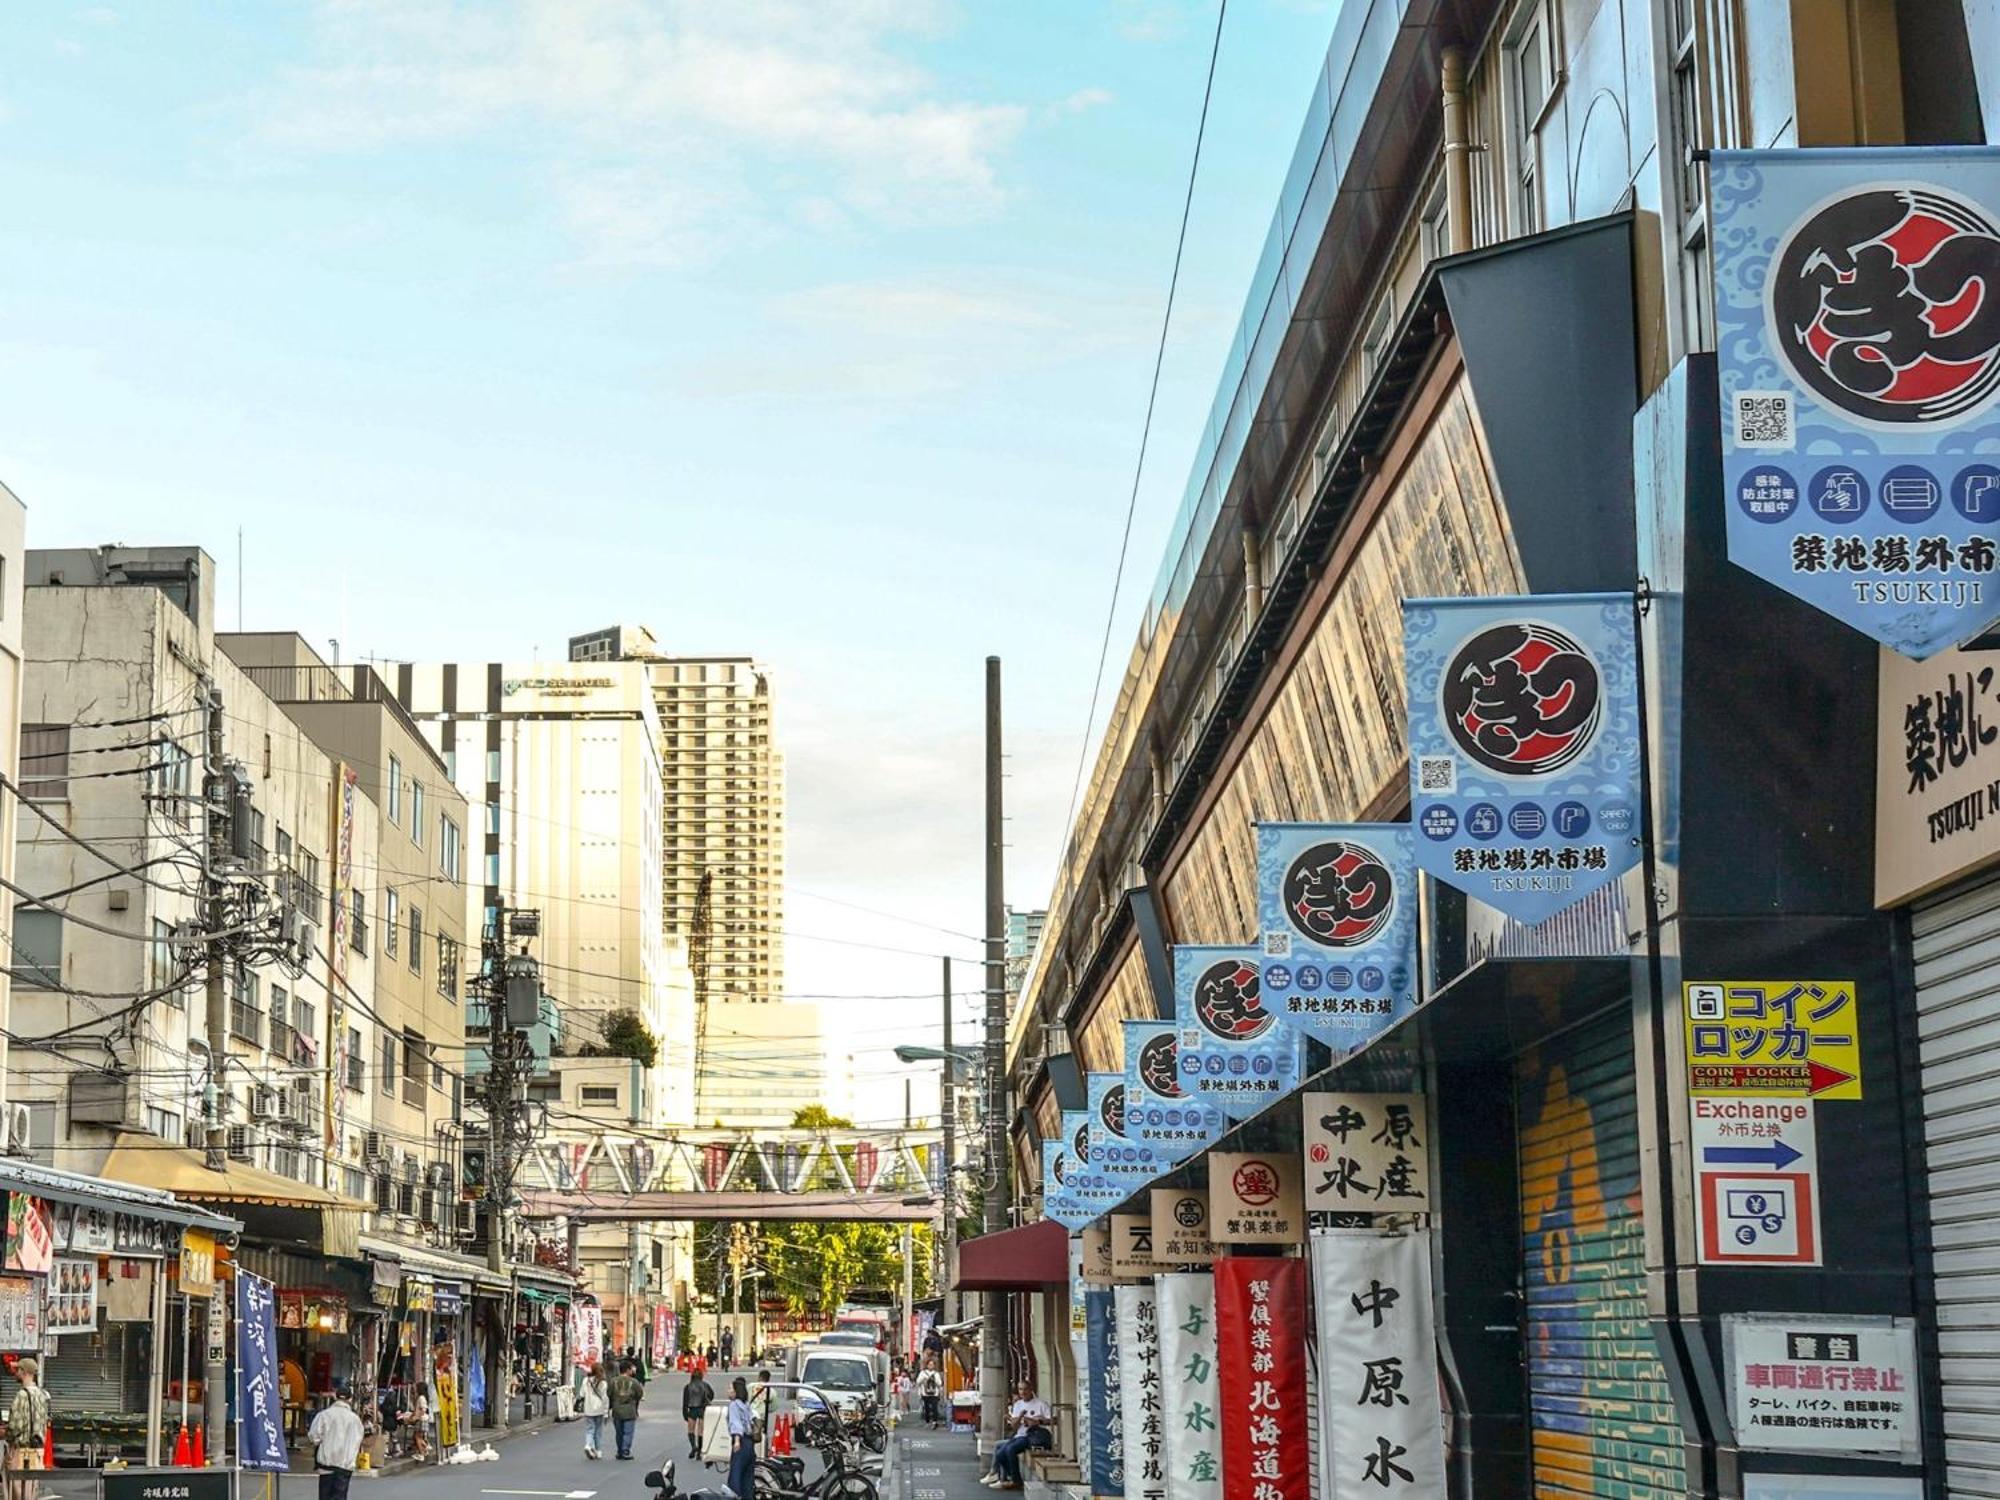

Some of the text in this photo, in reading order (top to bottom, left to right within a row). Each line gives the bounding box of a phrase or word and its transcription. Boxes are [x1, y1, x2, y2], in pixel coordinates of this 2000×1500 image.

[1742, 488, 1795, 500] 防止対策
[1755, 475, 1782, 487] 感染
[1750, 501, 1790, 513] 取組中
[1792, 534, 2000, 574] 築地場外市
[1855, 582, 1984, 607] TSUKIJI
[1904, 667, 2000, 795] 築地に
[1928, 790, 1984, 843] TSUKIJI
[1454, 846, 1607, 872] 築地場外市場
[1492, 877, 1572, 892] TSUKIJI
[1728, 983, 1849, 1022] コイン
[1693, 1023, 1851, 1059] ロッカー
[1695, 1067, 1811, 1077] COIN-LOCKER
[1696, 1100, 1807, 1122] Exchange
[1321, 1104, 1421, 1150] 中原
[1718, 1122, 1782, 1138] 外币兑换
[1315, 1155, 1426, 1200] 水産
[1227, 1219, 1289, 1234] 蟹倶楽部
[1793, 1336, 1851, 1359] 警告
[1136, 1300, 1164, 1482] 新潟中央水産市場
[1351, 1279, 1416, 1488] 中原水
[1745, 1363, 1905, 1393] 車両通行禁止
[1180, 1304, 1218, 1482] 与力水産
[1749, 1396, 1903, 1414] ターレ、バイク、自転車等は
